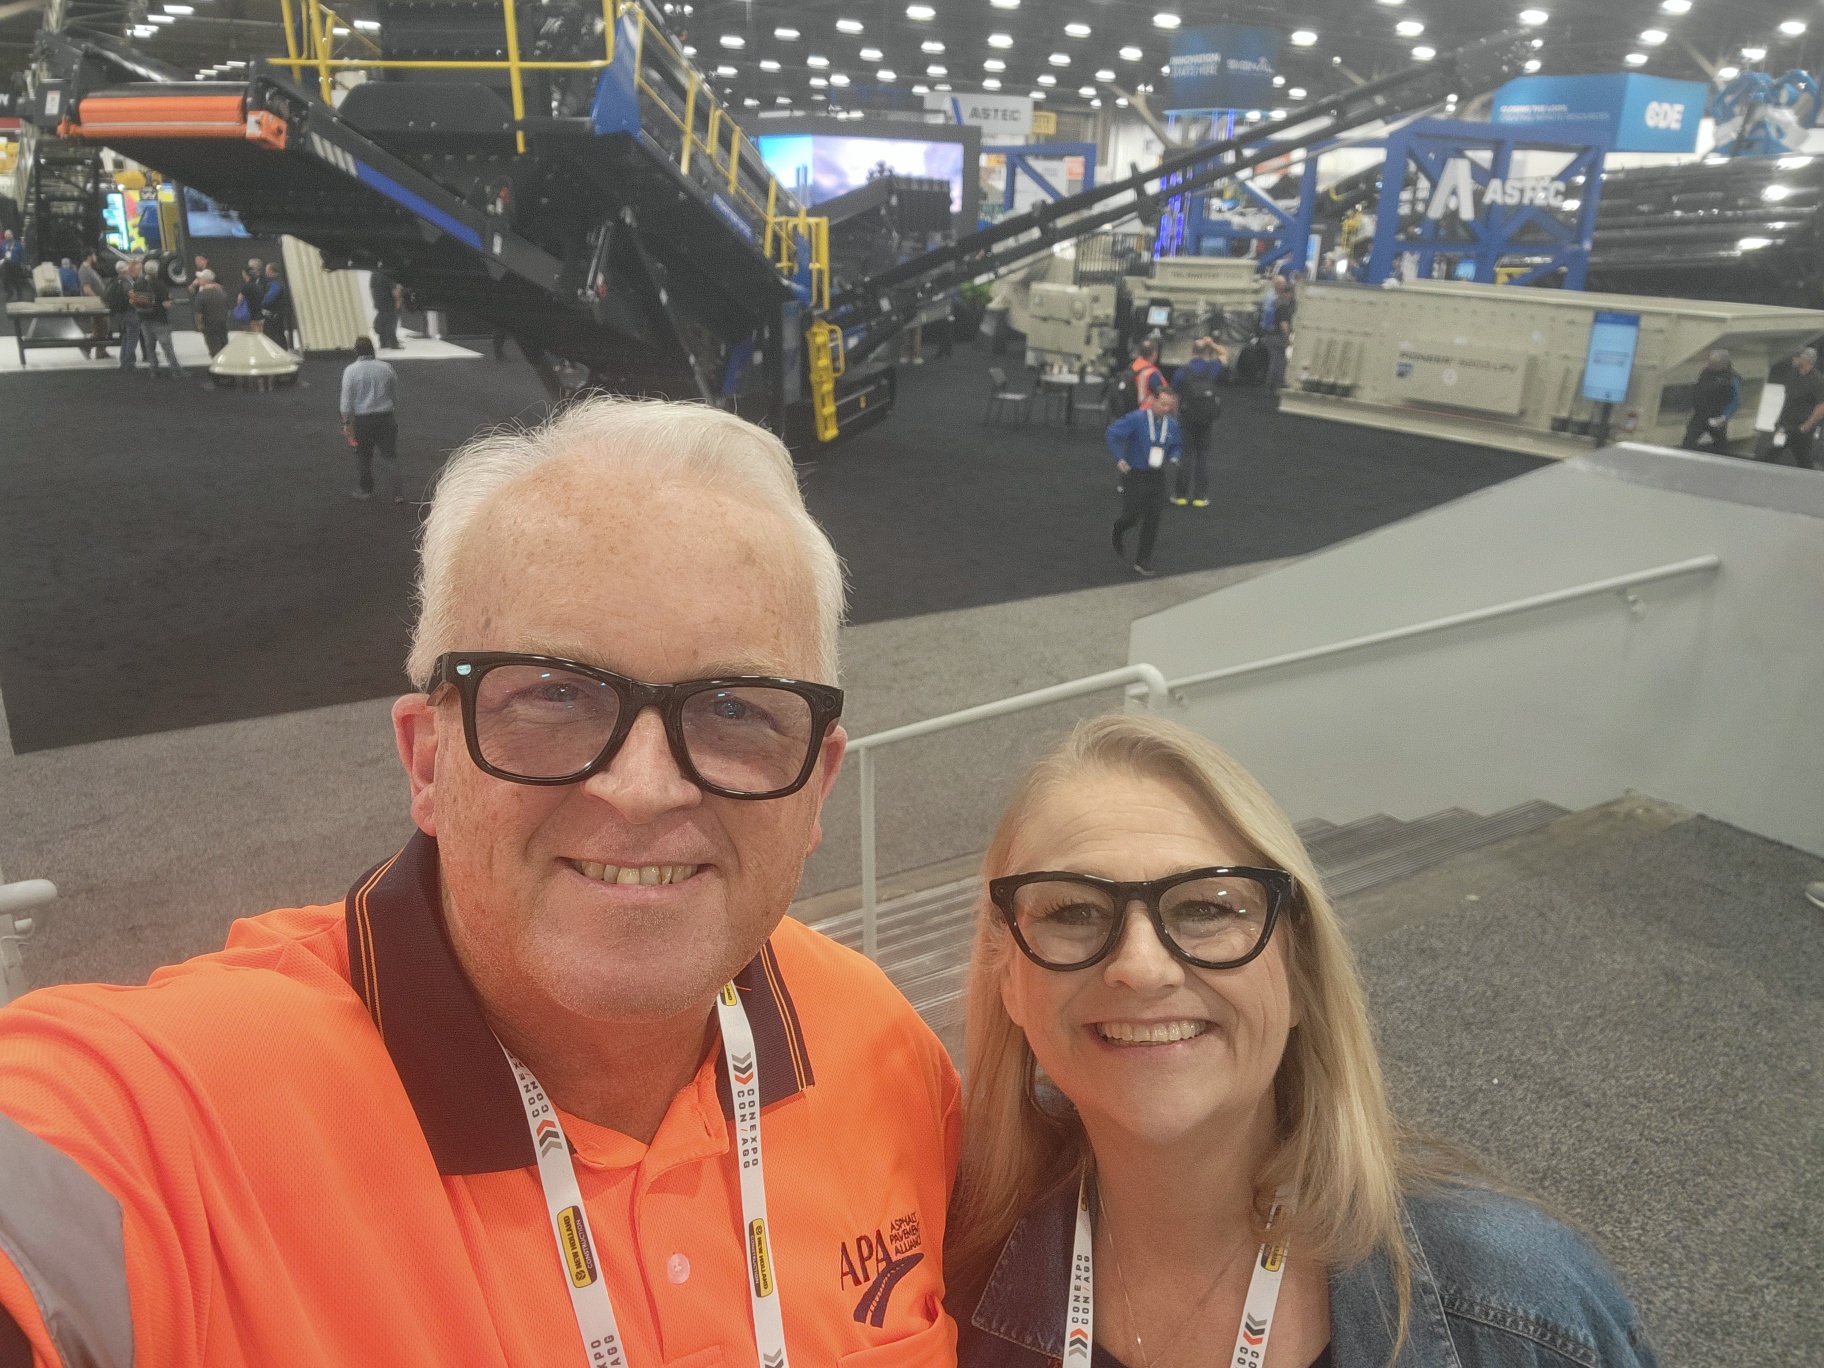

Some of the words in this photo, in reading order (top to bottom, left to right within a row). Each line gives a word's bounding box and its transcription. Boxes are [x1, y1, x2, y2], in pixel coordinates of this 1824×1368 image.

[968, 106, 1022, 121] ASTEC
[1645, 101, 1685, 131] CDE
[1482, 178, 1566, 208] ASTEC
[737, 1090, 750, 1168] CON/AGG
[747, 1088, 759, 1166] CONEXPO
[563, 1215, 578, 1251] HOLLAND
[575, 1219, 593, 1269] CONSTRUCTION
[890, 1212, 917, 1234] ASPHALT
[571, 1250, 583, 1270] NEW
[750, 1235, 760, 1284] CONSTRUCTION
[759, 1255, 768, 1290] HOLLAND
[840, 1229, 893, 1291] APA
[1071, 1253, 1083, 1324] CONEXPO
[1081, 1255, 1091, 1325] CON/AGG
